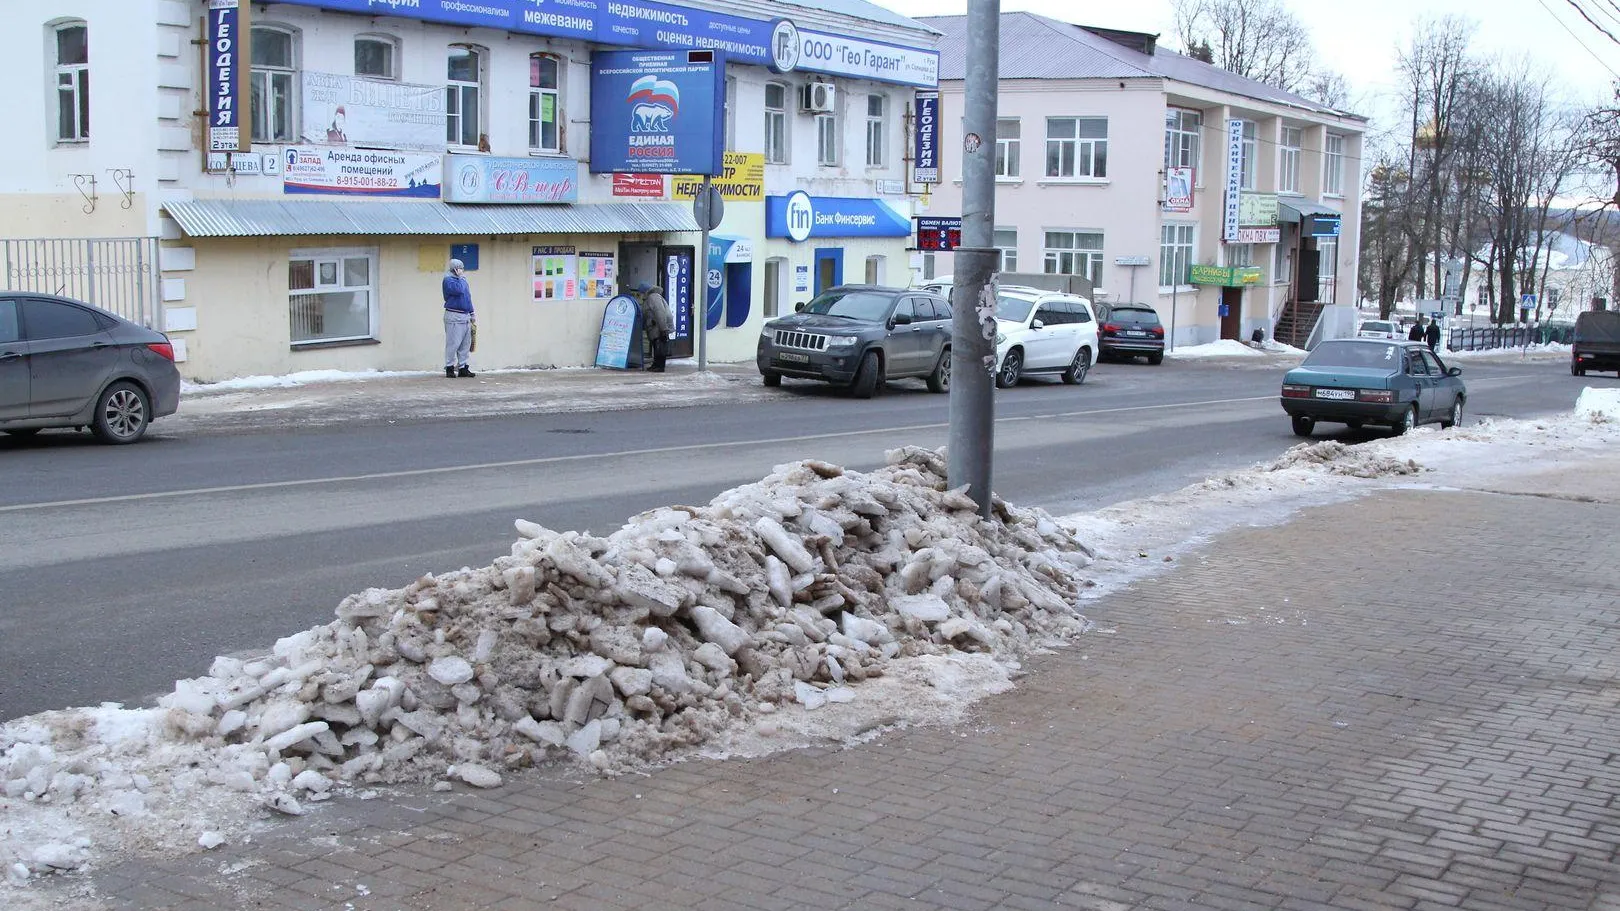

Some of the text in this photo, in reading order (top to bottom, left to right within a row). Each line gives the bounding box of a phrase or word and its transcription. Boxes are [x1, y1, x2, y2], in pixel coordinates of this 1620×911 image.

[441, 1, 510, 17] профессионализм
[608, 2, 689, 26] недвижимость
[524, 10, 593, 31] межевание
[708, 21, 736, 33] доступные
[612, 25, 639, 36] качество
[656, 30, 767, 57] оценка недвижимости
[804, 39, 832, 61] ООО
[216, 10, 232, 126] ГЕОДЕЗИЯ
[920, 98, 932, 167] ГЕОДЕЗИЯ
[213, 141, 219, 149] 2
[629, 136, 675, 146] ЕДИНАЯ
[328, 151, 362, 165] Аренда
[365, 153, 405, 165] офисных
[629, 147, 674, 157] РОССИЯ
[269, 158, 275, 170] 2
[299, 157, 321, 165] ЗАПАД
[1230, 121, 1241, 199] ЮРИДИЧЕСКИЙ
[341, 165, 393, 176] помещений
[336, 176, 398, 188] 8-915-001-88-22
[790, 202, 809, 229] fin
[815, 211, 875, 228] Банк Финсервис
[1228, 203, 1236, 239] ЦЕНТР
[1255, 231, 1267, 242] ПВХ
[709, 271, 720, 280] 24
[1192, 266, 1229, 278] КАРНИЗЫ
